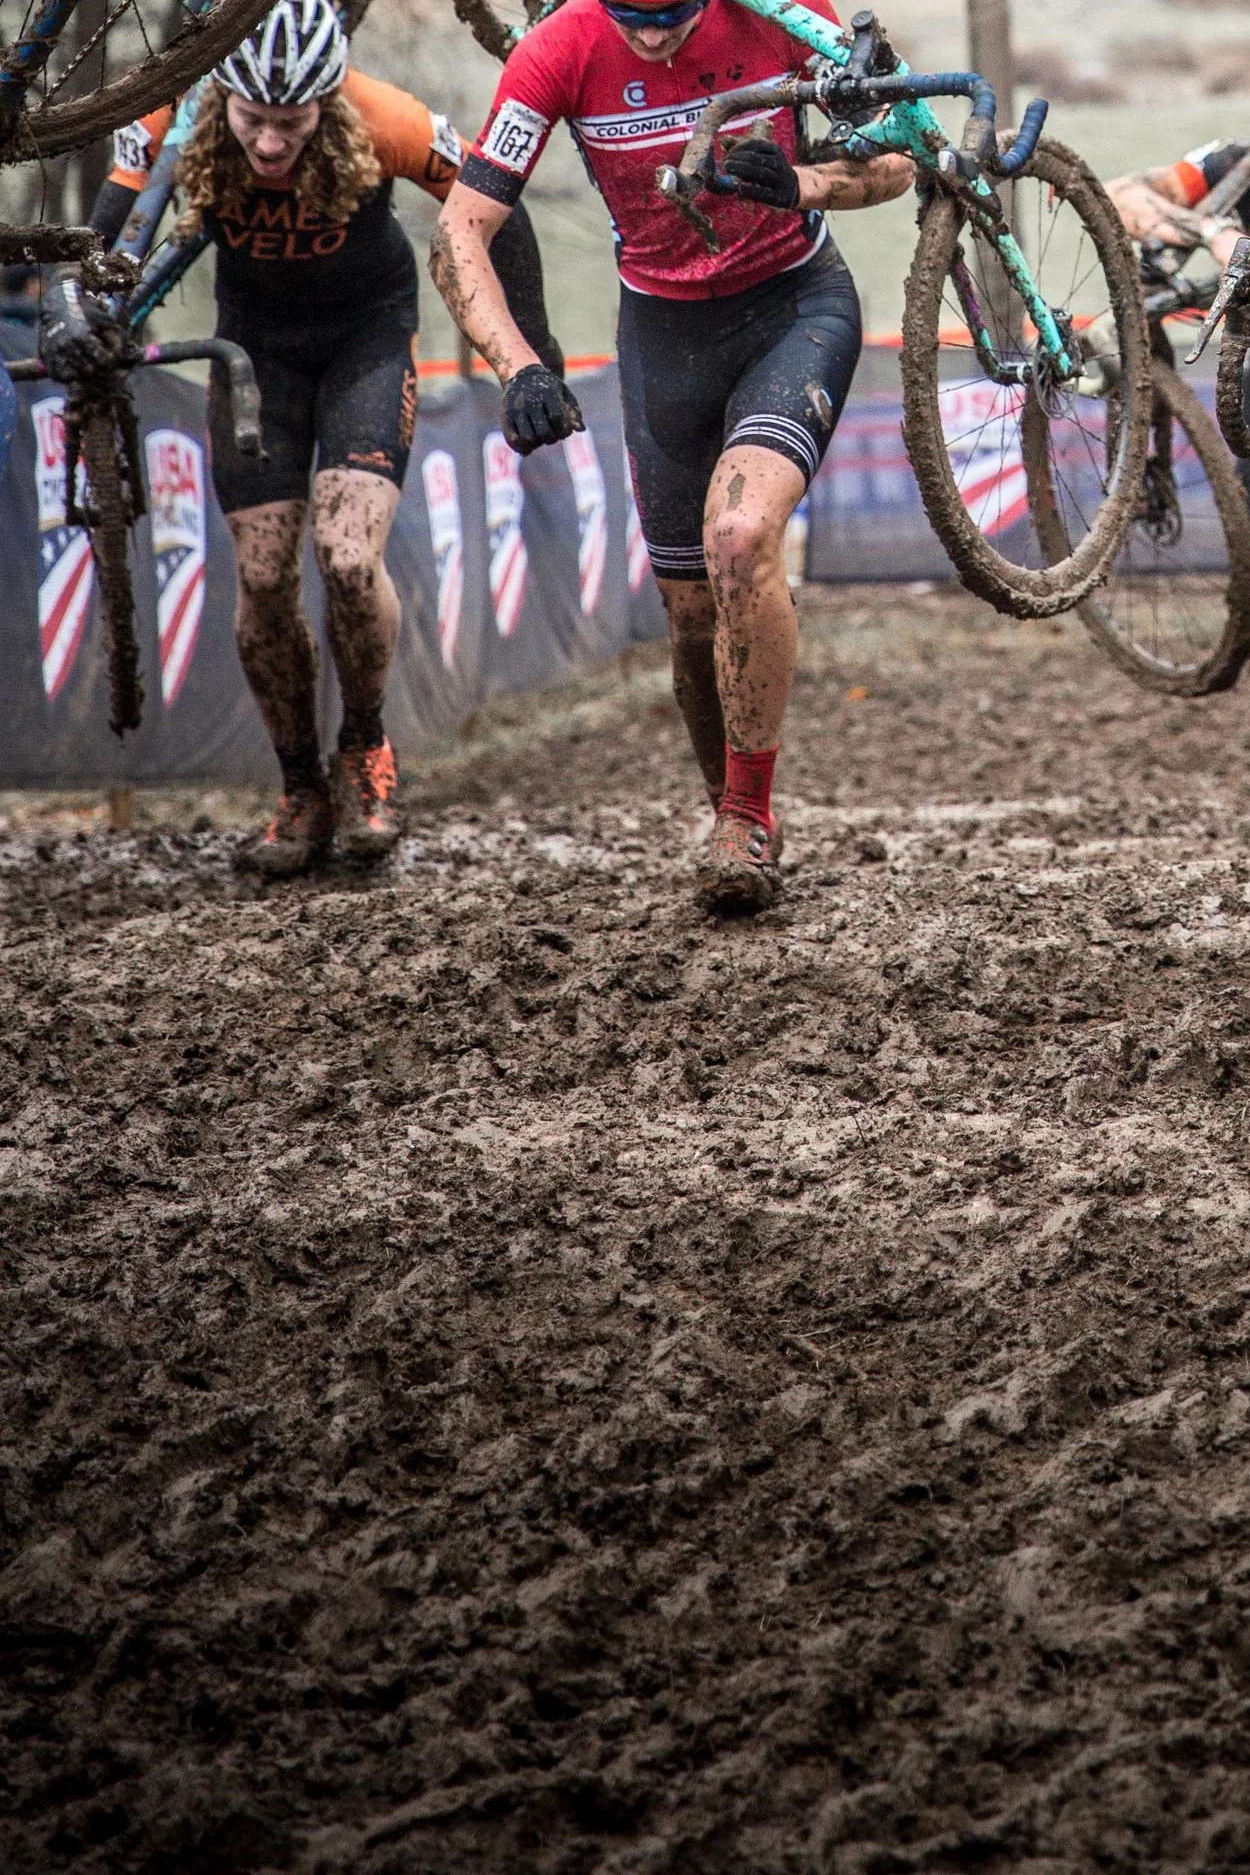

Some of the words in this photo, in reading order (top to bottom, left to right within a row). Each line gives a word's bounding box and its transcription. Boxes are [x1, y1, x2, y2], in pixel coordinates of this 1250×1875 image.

[493, 120, 534, 162] 167
[597, 117, 679, 137] COLONIAL
[215, 198, 350, 231] AME
[222, 223, 348, 260] VELO
